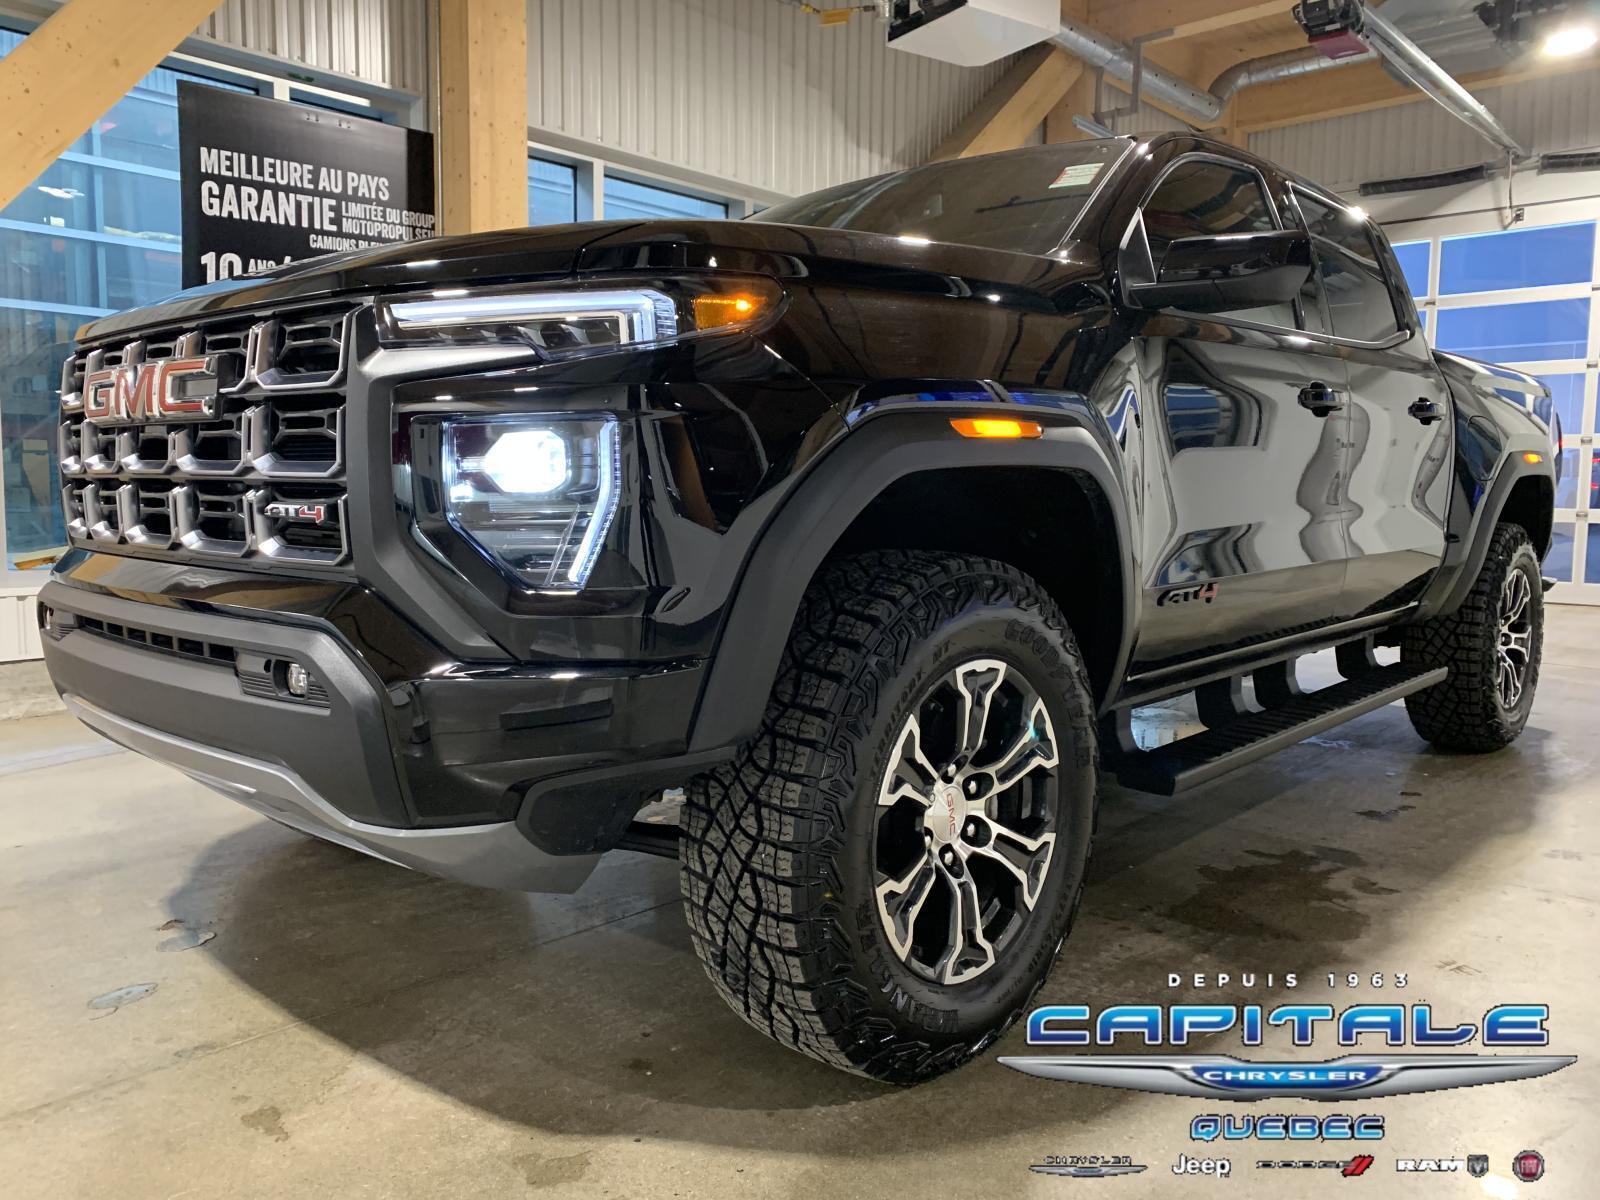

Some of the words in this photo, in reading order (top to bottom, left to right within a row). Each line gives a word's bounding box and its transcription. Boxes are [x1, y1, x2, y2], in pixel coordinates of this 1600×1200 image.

[200, 146, 314, 190] MEILLEURE
[318, 166, 342, 194] AU
[347, 171, 390, 201] PAYS
[201, 180, 337, 232] GARANTIE
[342, 201, 384, 222] LIMITÉE
[385, 207, 400, 224] DU
[309, 233, 357, 252] CAMIONS
[200, 251, 243, 284] 10
[84, 355, 217, 421] GMC
[945, 792, 956, 837] GMC
